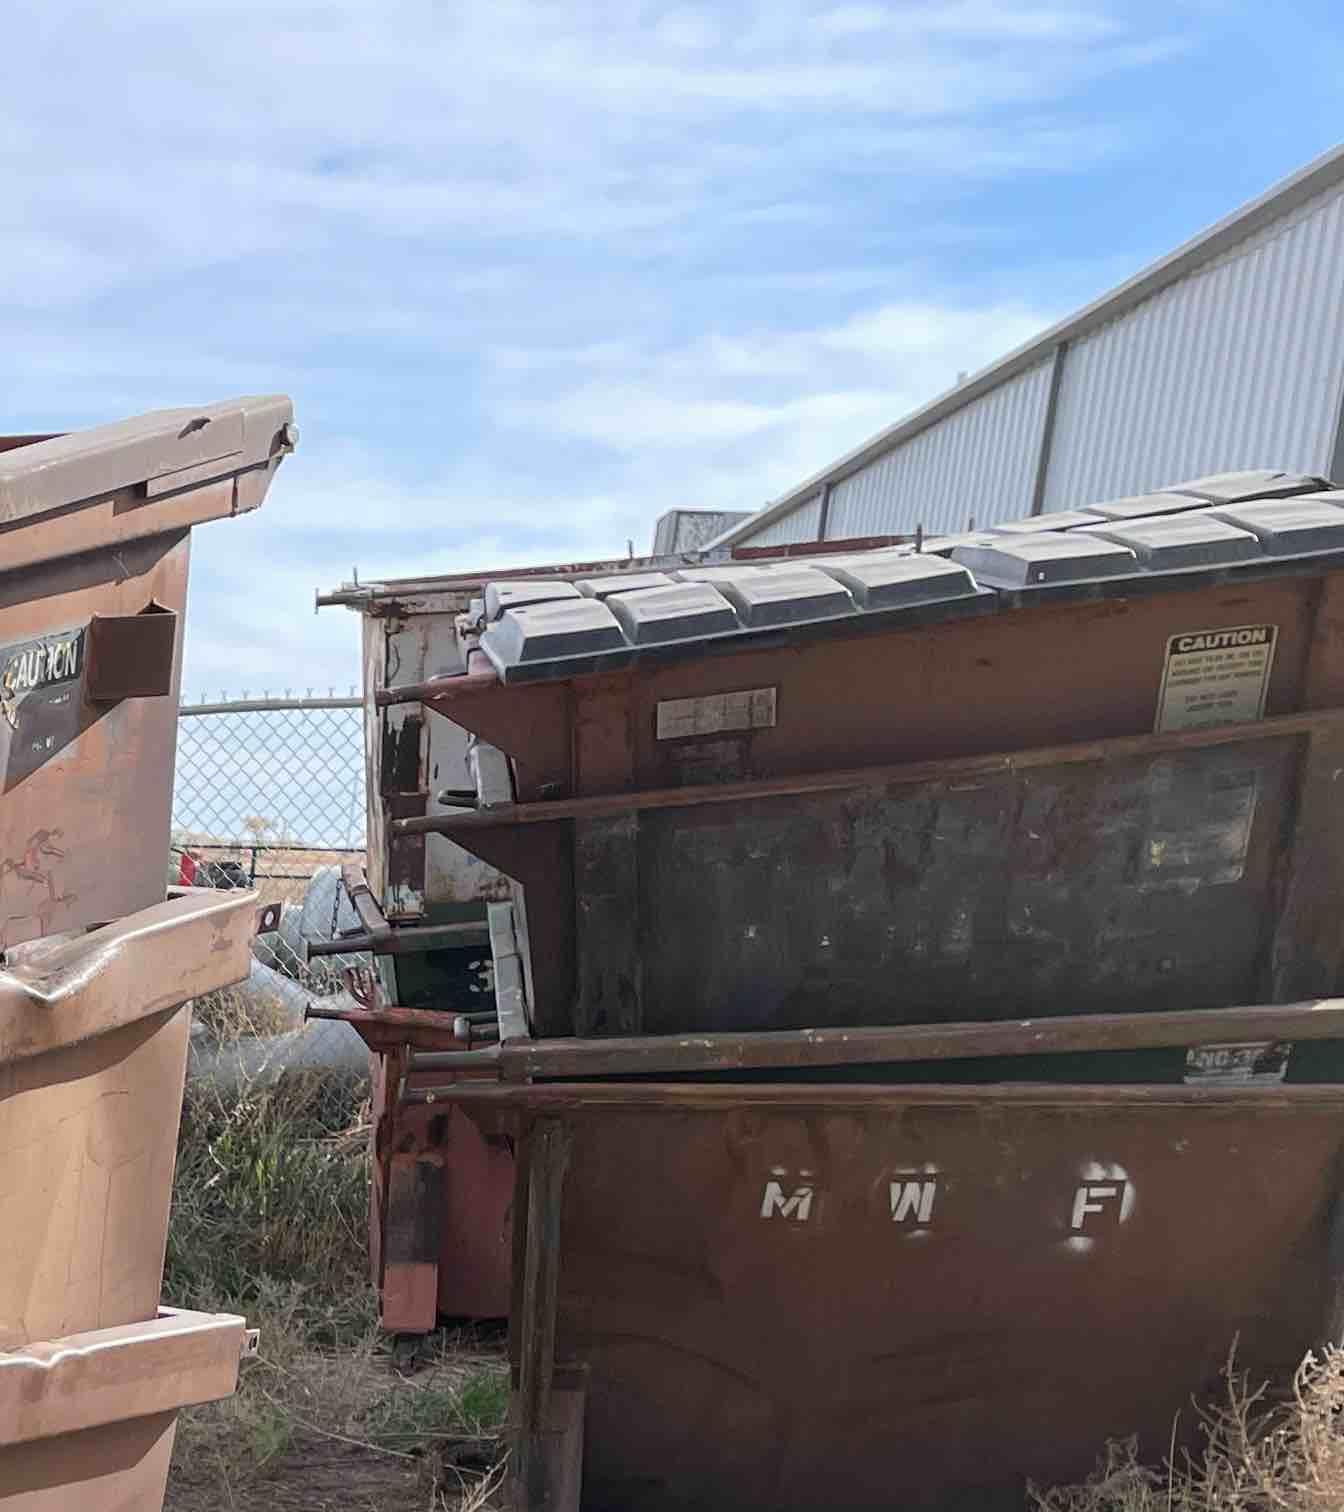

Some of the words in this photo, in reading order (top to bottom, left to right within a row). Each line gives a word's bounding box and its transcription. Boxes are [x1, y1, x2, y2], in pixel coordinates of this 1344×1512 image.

[3, 639, 78, 690] CAUTION
[1178, 628, 1267, 653] CAUTION
[759, 1180, 815, 1222] M
[889, 1180, 937, 1223] W
[1070, 1186, 1117, 1231] F
